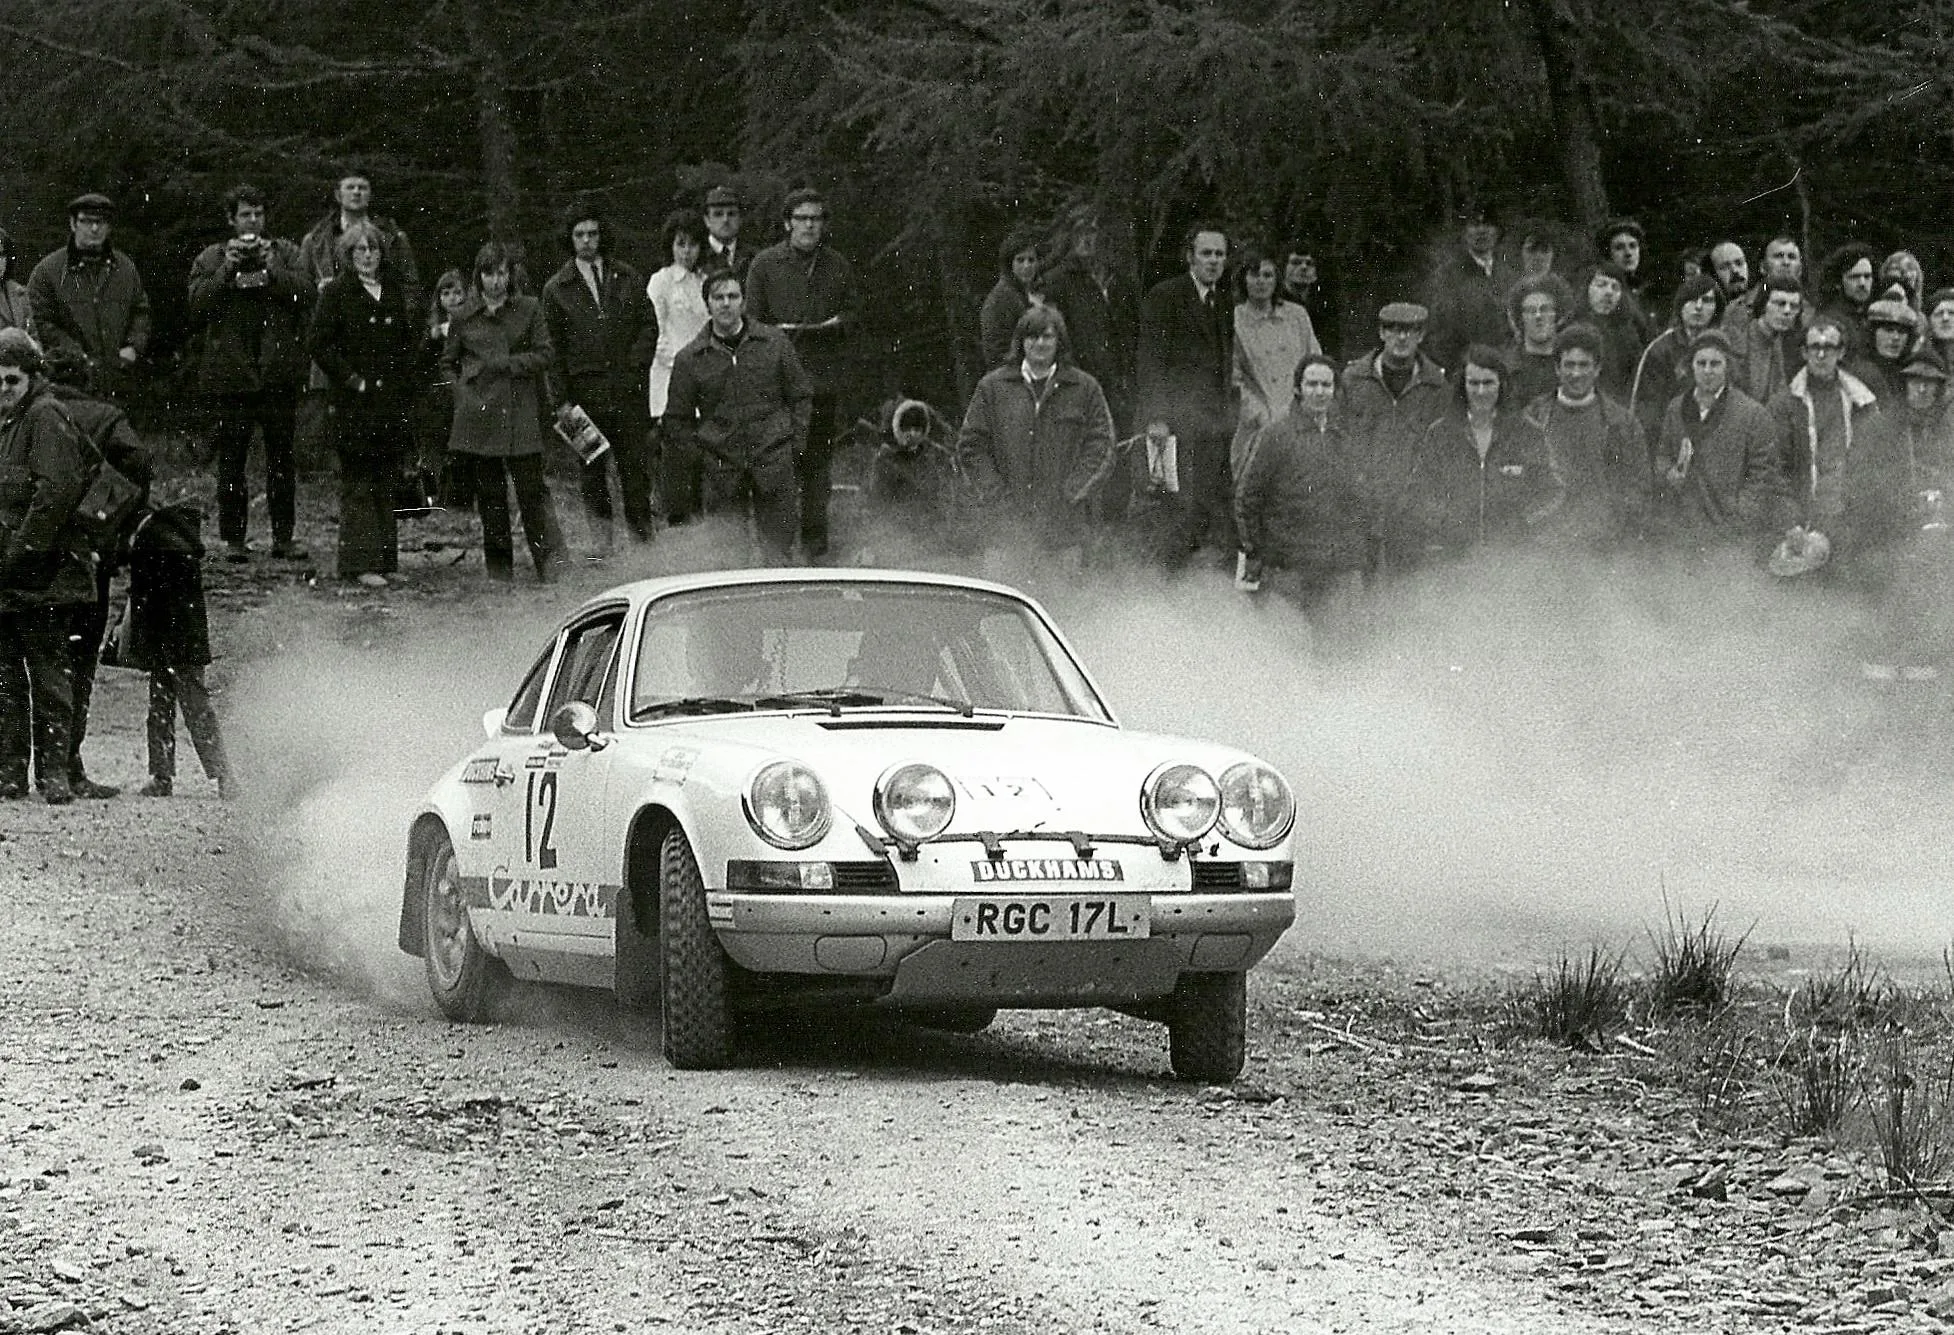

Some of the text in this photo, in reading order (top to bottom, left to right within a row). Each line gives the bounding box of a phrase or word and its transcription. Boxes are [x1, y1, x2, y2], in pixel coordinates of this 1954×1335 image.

[525, 771, 557, 870] 12
[977, 861, 1117, 881] DUCKHAMS
[976, 901, 1129, 935] RGC 17L
